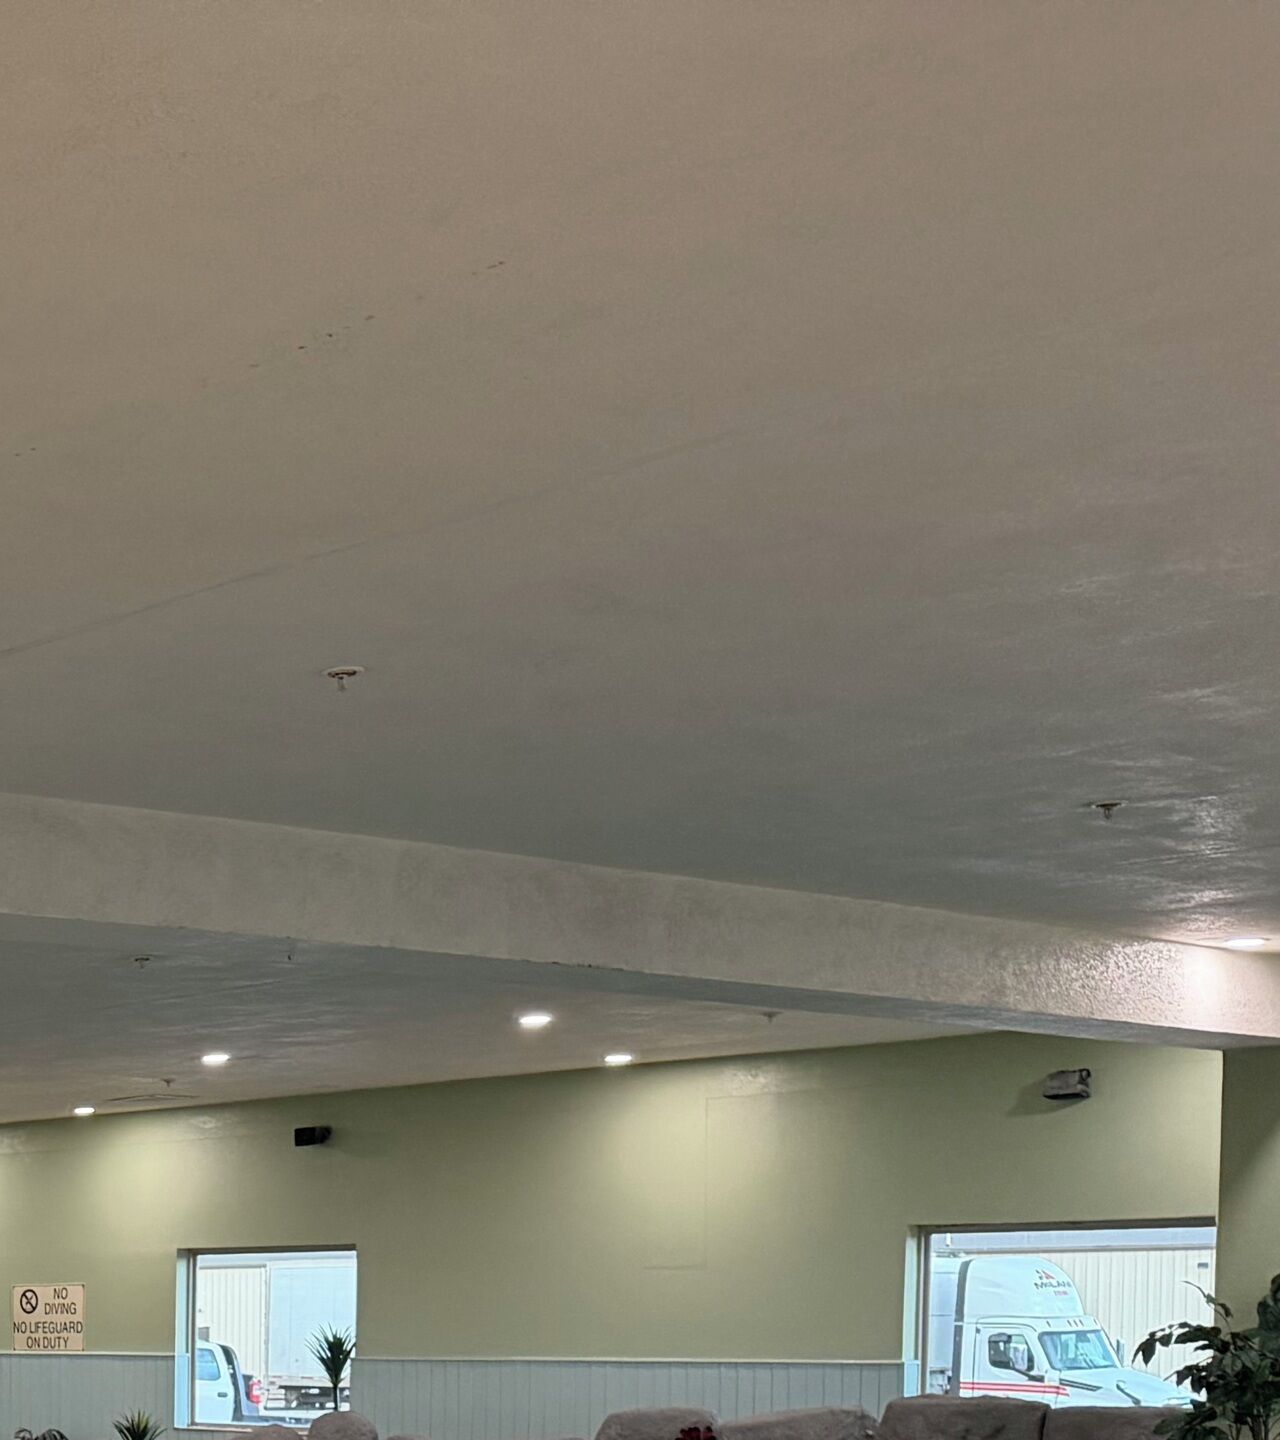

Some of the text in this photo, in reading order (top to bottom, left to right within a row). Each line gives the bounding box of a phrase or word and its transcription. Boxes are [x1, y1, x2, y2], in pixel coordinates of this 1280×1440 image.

[53, 1287, 68, 1300] NO
[44, 1302, 77, 1315] DIVING
[13, 1321, 83, 1334] NO LIFEGUARD
[26, 1336, 69, 1349] ON DUTY
